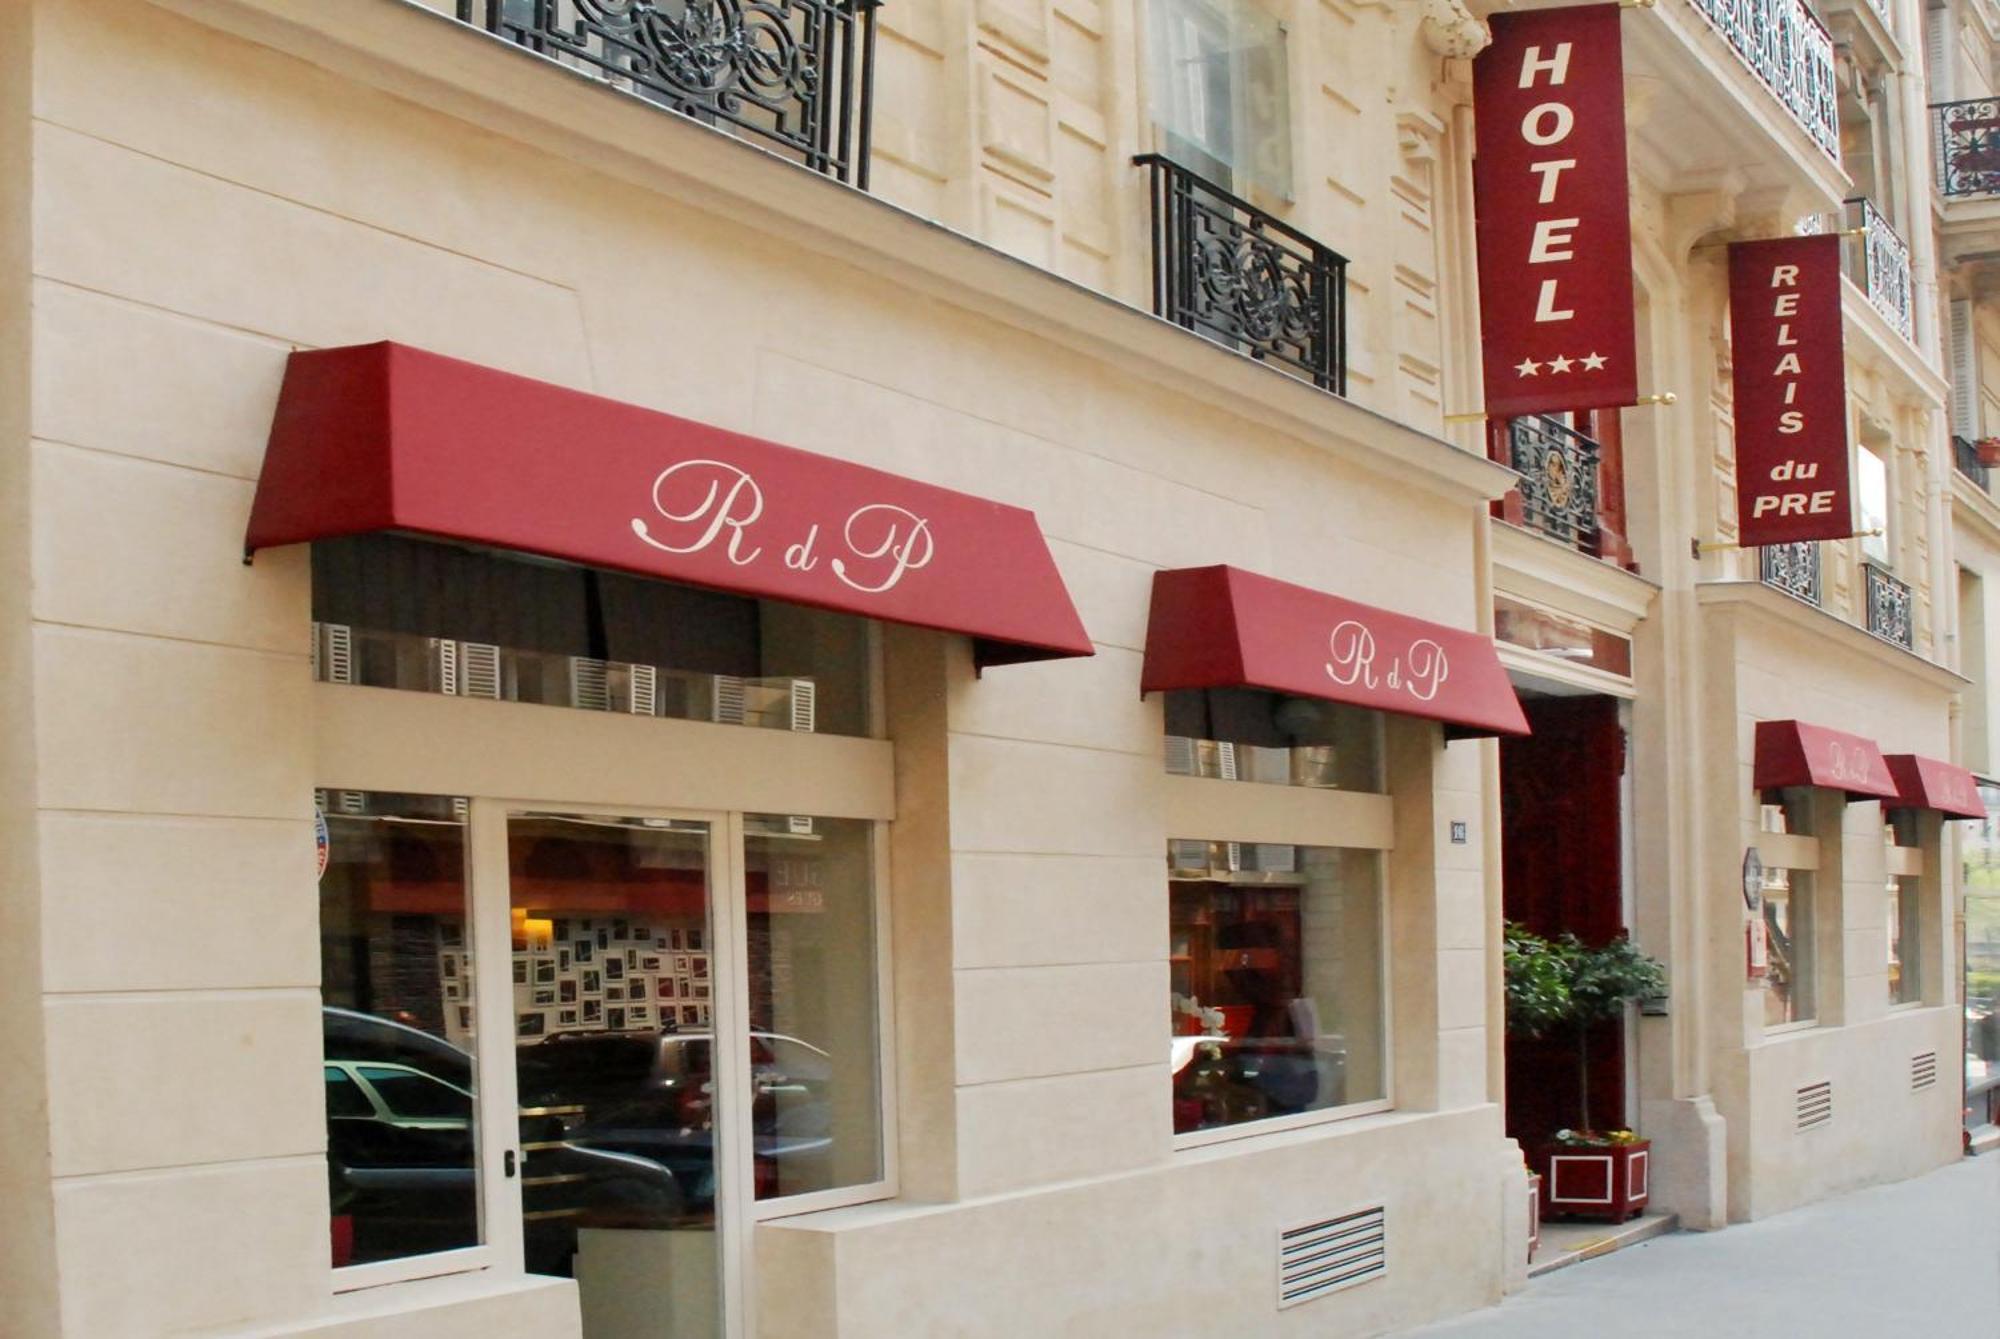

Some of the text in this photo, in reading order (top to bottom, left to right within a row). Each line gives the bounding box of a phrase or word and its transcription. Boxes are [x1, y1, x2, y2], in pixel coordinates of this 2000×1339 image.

[1518, 42, 1580, 323] HOTEL
[1771, 264, 1804, 434] RELAIS
[1752, 490, 1836, 518] PRE
[1769, 460, 1818, 481] du
